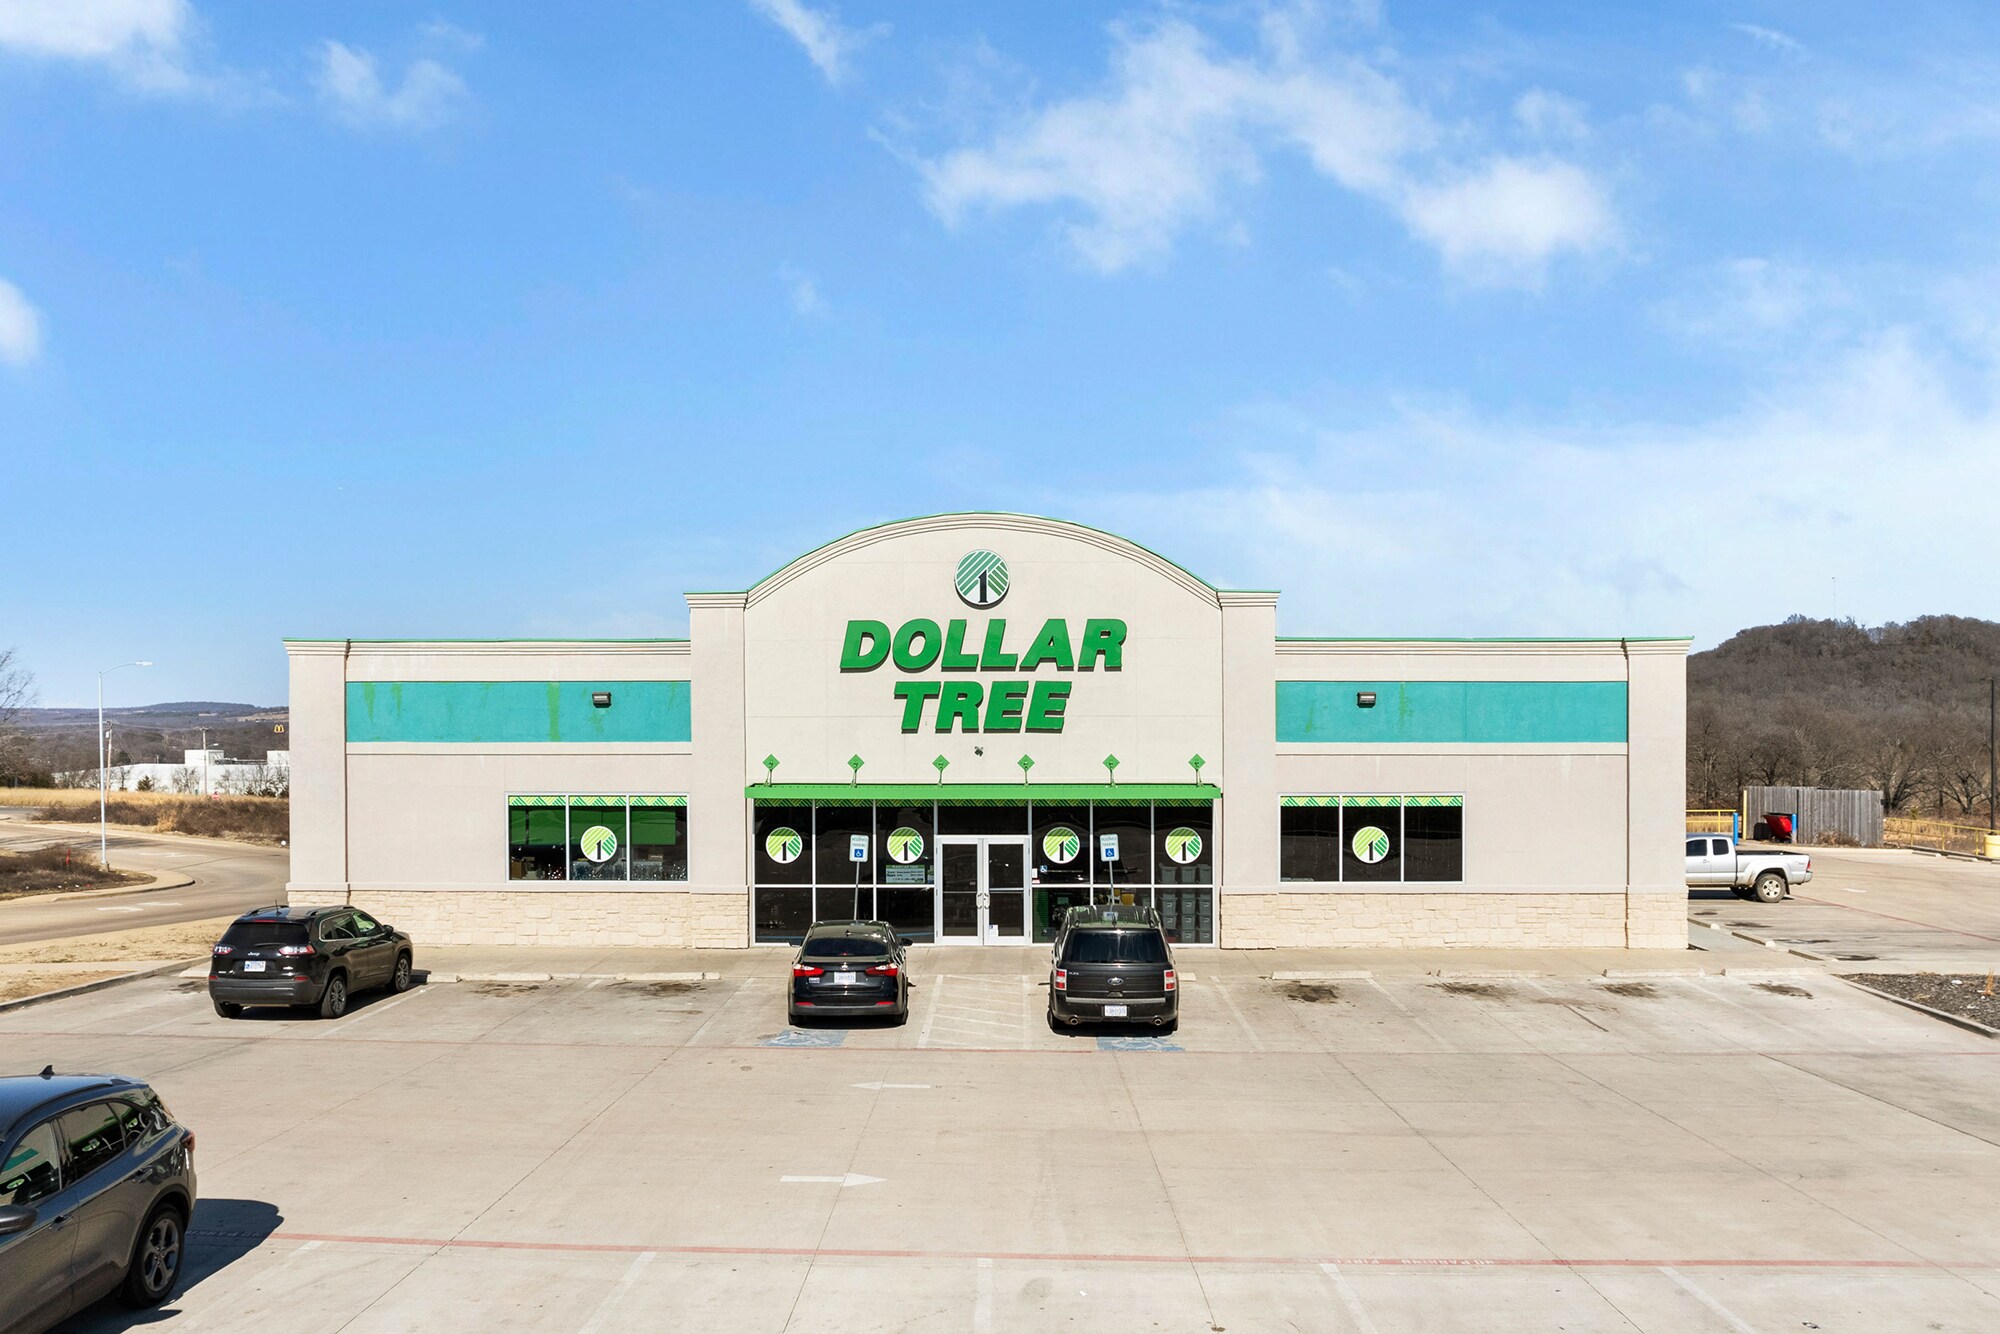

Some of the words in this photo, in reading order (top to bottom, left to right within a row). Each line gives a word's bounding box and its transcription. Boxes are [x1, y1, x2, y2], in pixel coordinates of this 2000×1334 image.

[978, 569, 988, 603] 1
[840, 618, 1127, 672] DOLLAR
[894, 681, 1072, 733] TREE
